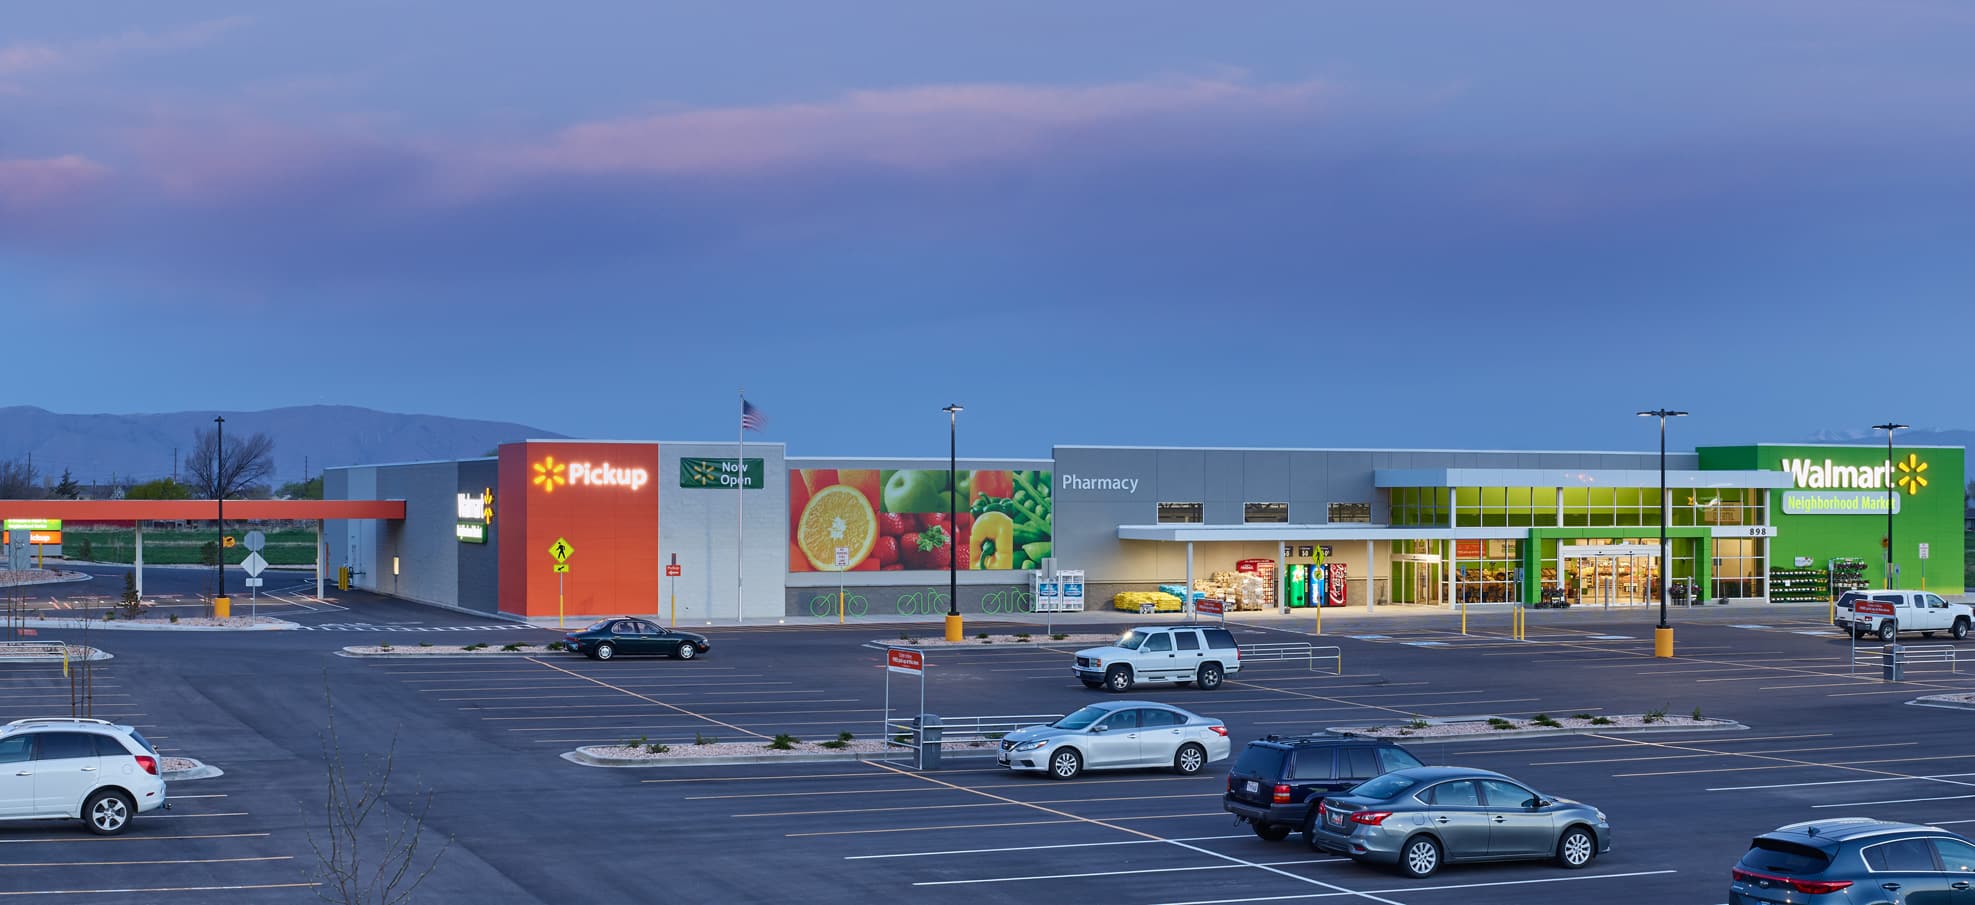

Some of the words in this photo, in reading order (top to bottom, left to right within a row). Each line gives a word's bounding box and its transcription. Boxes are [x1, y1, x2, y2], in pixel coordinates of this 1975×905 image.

[722, 462, 748, 472] Now
[1782, 458, 1895, 488] Walmart
[568, 462, 649, 491] Pickup
[720, 474, 752, 487] Open
[1062, 474, 1139, 493] Pharmacy
[1788, 496, 1858, 512] Neighborhood
[1749, 528, 1767, 536] 898
